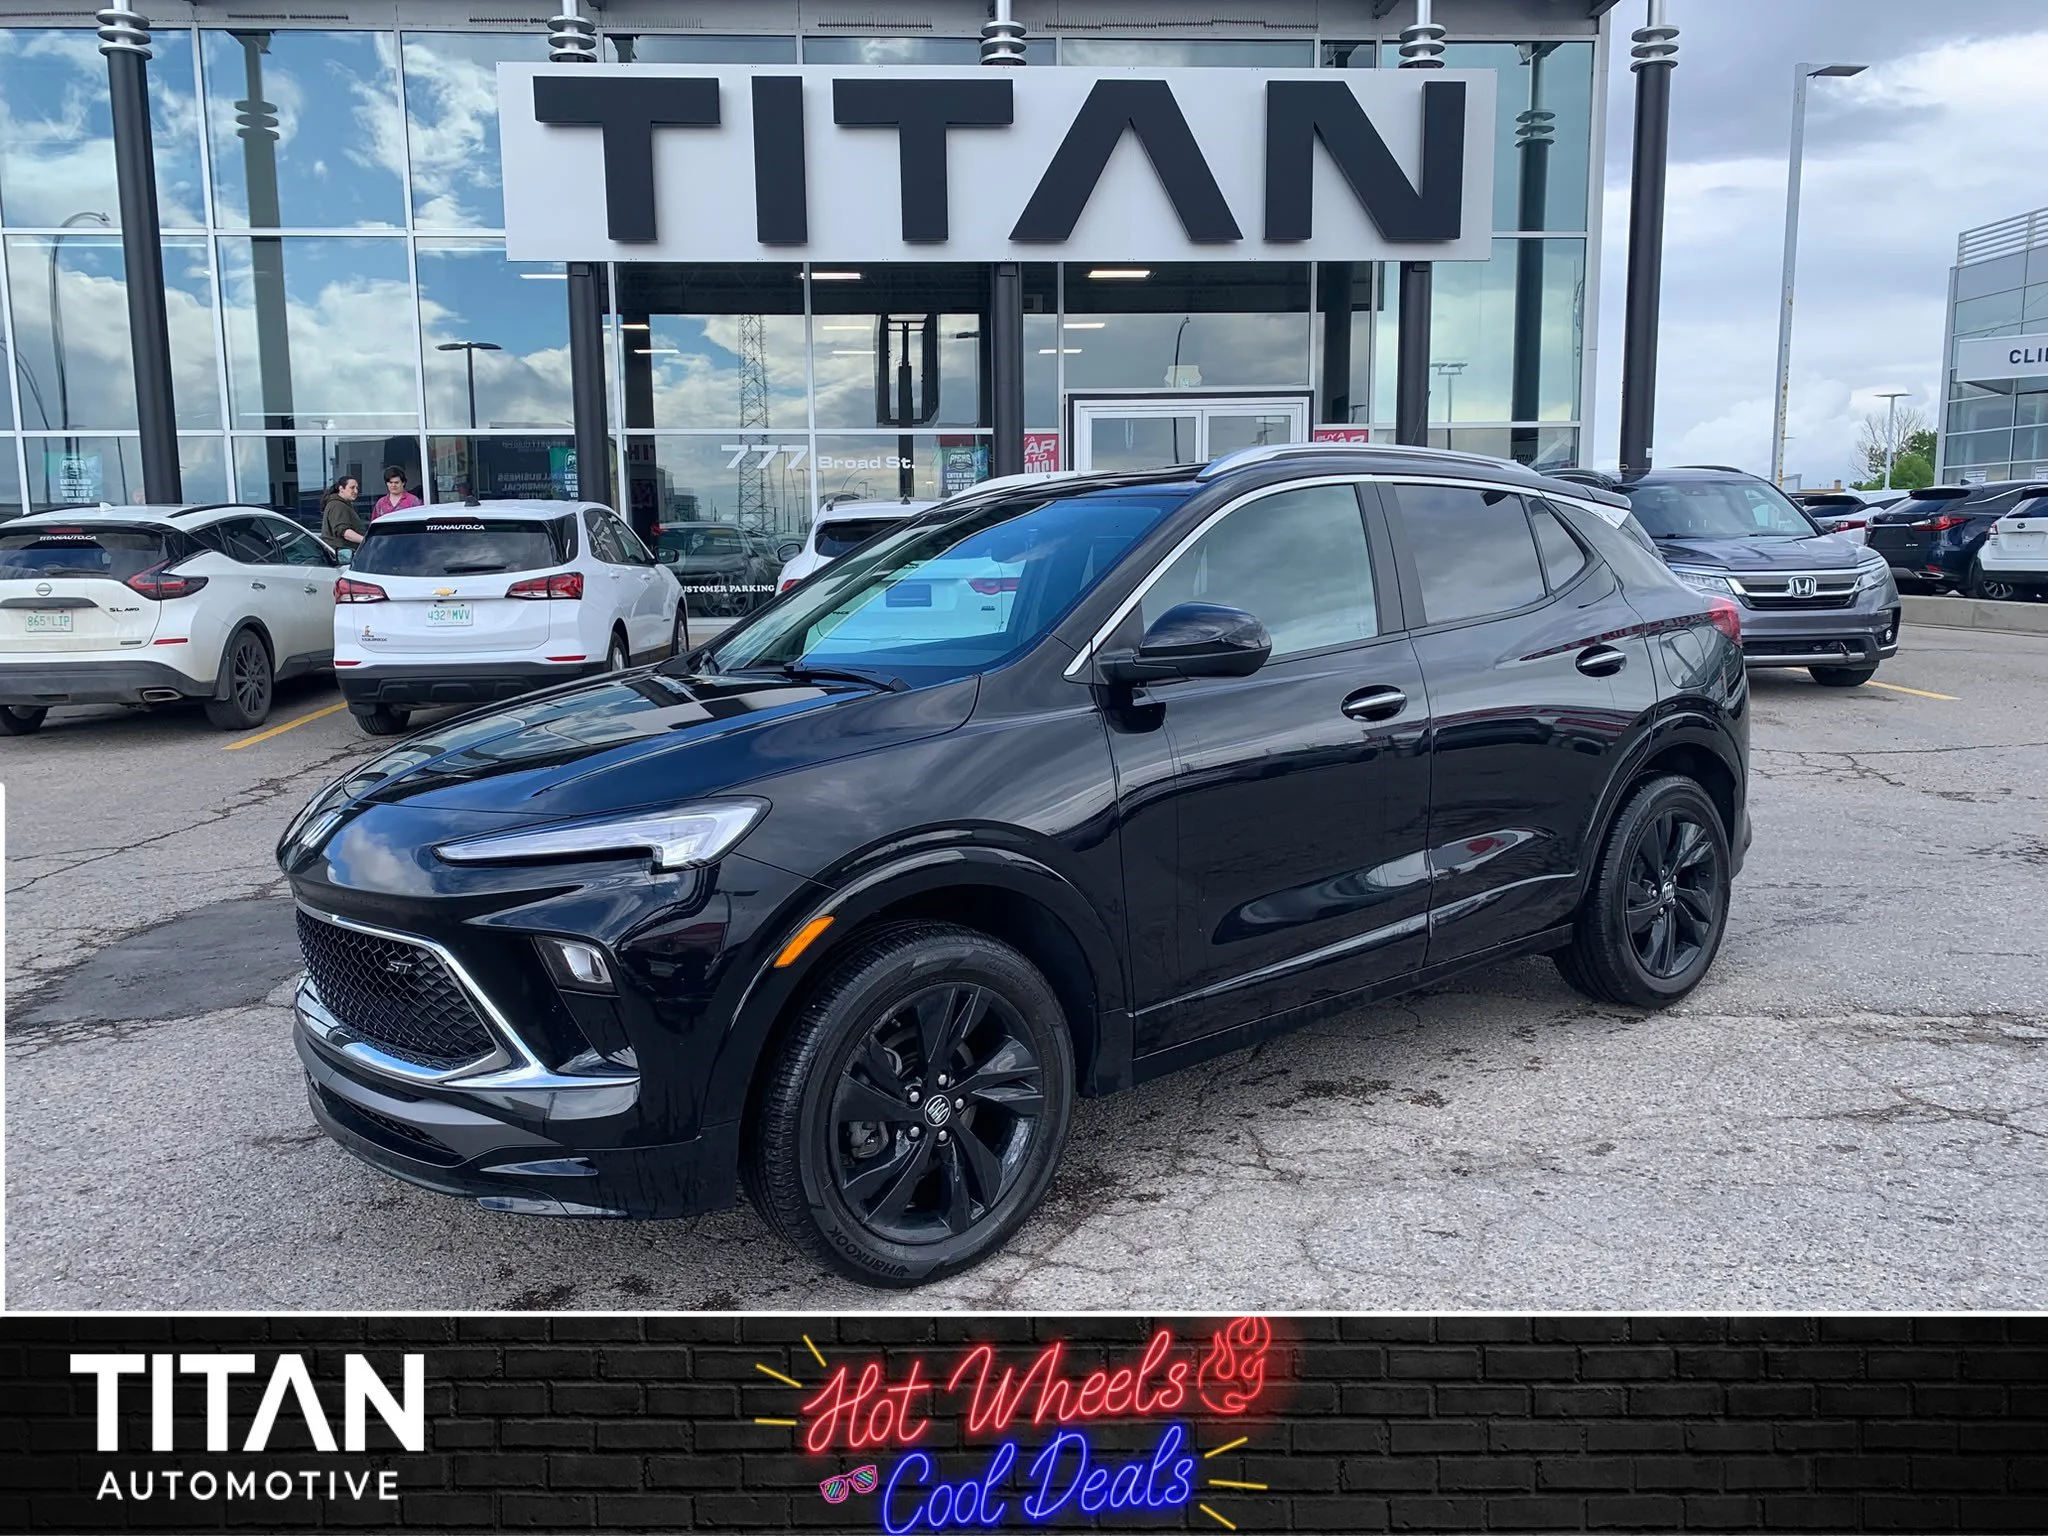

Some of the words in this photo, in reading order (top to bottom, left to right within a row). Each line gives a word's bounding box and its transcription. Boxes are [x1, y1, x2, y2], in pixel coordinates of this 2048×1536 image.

[532, 75, 1467, 244] TITAN
[1024, 440, 1056, 455] AR
[720, 444, 809, 469] 777
[819, 456, 881, 469] Broad
[885, 456, 915, 469] St.
[682, 585, 728, 593] USTOMER
[729, 584, 775, 592] PARKING
[27, 615, 46, 627] 865
[51, 615, 71, 626] LIP
[427, 610, 448, 621] 432
[452, 610, 471, 621] MVV
